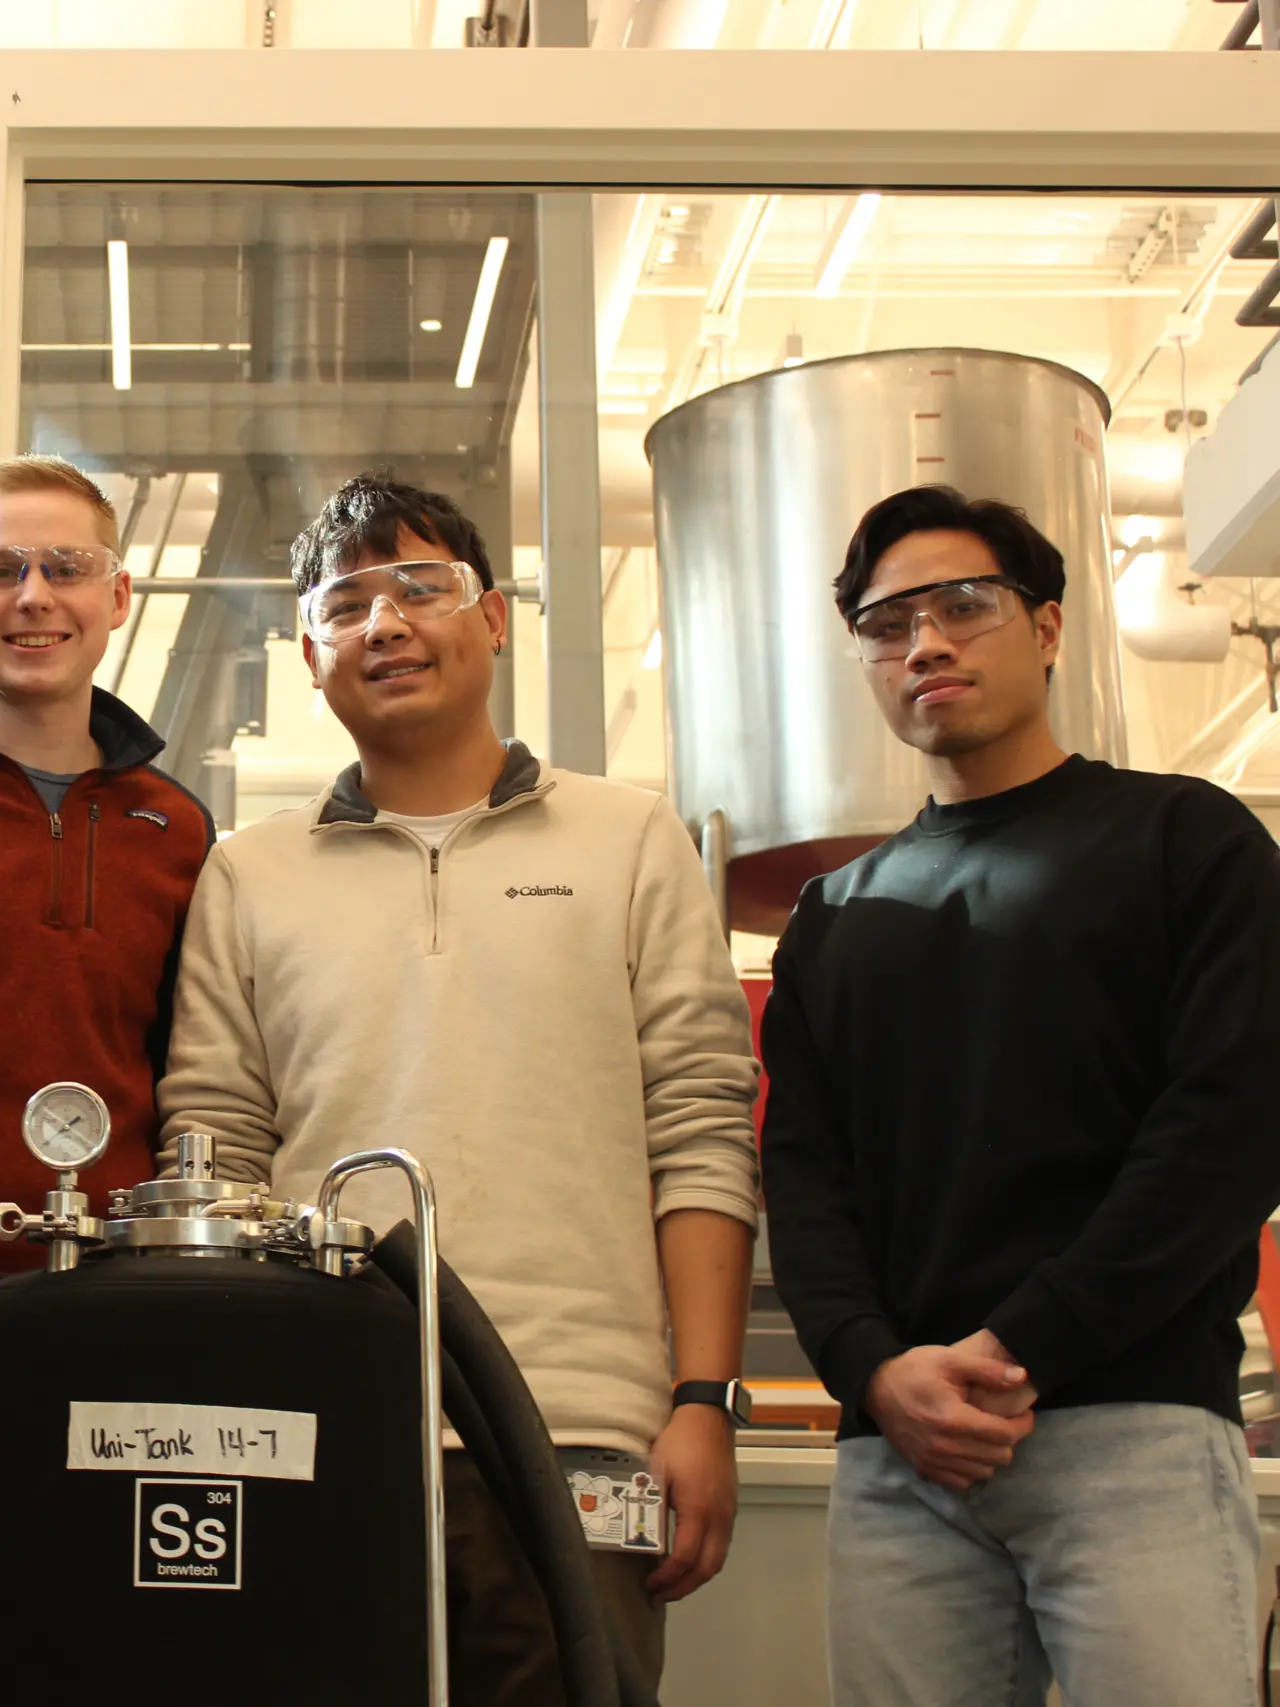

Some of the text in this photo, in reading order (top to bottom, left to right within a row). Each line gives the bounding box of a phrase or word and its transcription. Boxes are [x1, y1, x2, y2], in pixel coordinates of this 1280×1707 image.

[519, 885, 574, 896] Columbia
[90, 1427, 277, 1460] Uni-Tank 14-7
[206, 1492, 232, 1504] 304
[149, 1503, 228, 1560] Ss
[156, 1562, 218, 1577] brewtech
